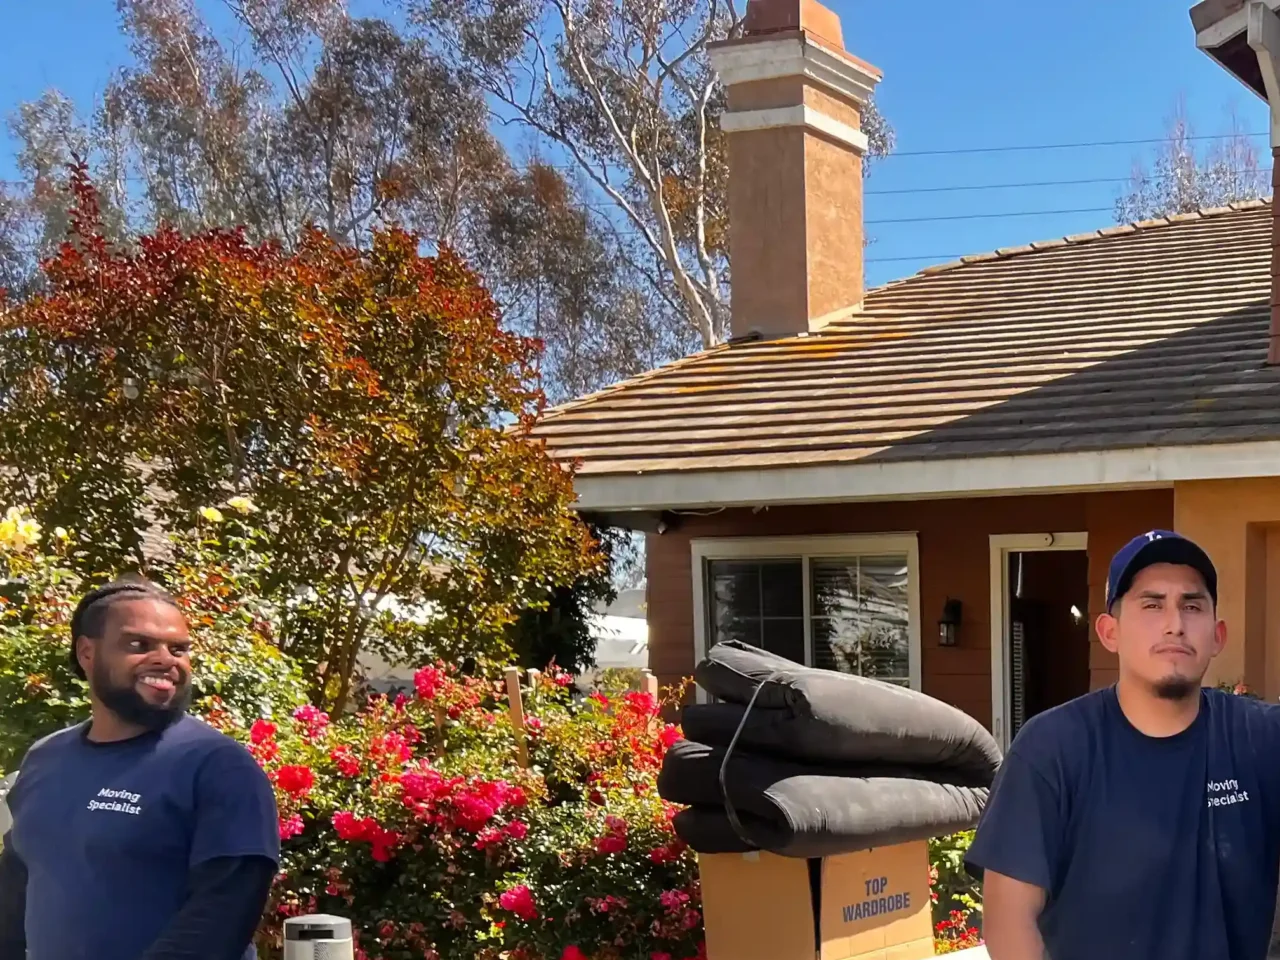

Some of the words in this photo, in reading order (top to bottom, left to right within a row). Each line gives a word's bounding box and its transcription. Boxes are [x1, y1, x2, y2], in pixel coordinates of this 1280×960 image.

[97, 788, 141, 803] Moving
[87, 800, 141, 815] Specialist
[865, 877, 888, 896] TOP
[843, 892, 911, 922] WARDROBE
